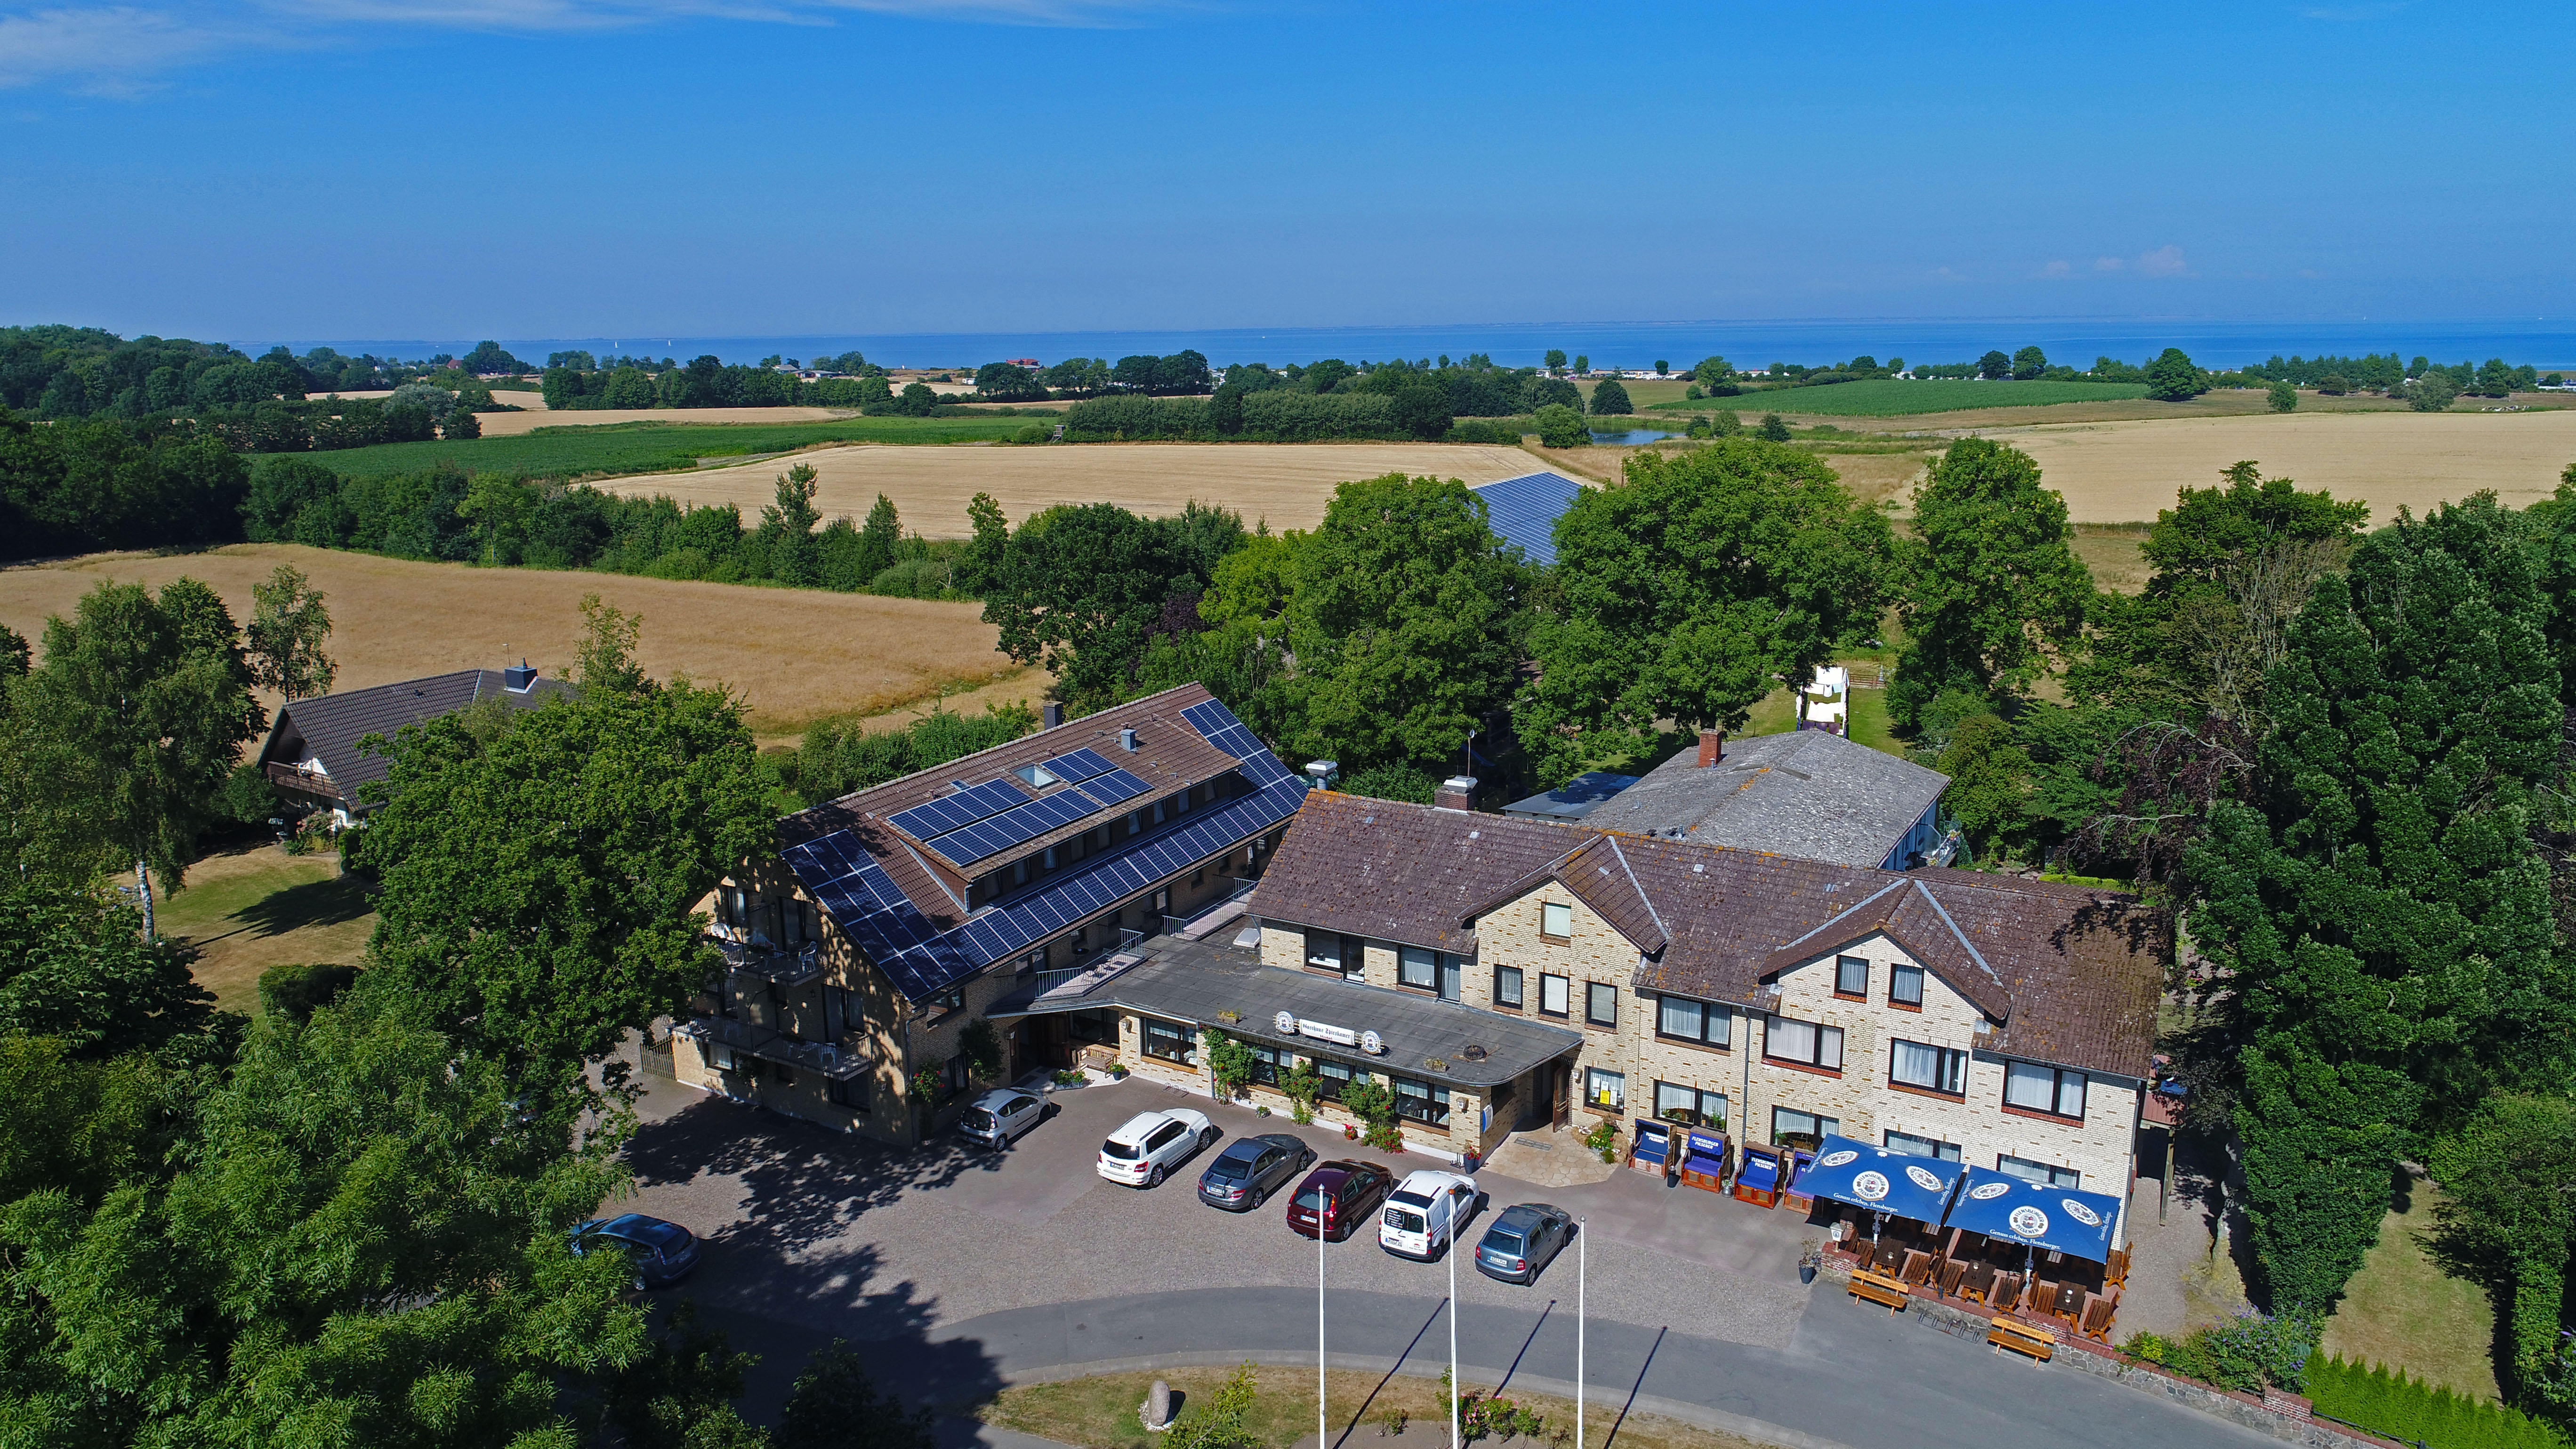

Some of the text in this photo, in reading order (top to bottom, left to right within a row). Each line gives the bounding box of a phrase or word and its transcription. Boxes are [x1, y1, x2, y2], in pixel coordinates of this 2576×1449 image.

[1691, 1136, 1719, 1147] FLENSBURGER
[1695, 1141, 1714, 1150] PILSENER
[1755, 1162, 1772, 1170] PILSENER
[1858, 1174, 1885, 1186] FLENSBURGER
[1858, 1188, 1880, 1197] PILSENER
[1834, 1192, 1899, 1213] Genuss erleben. Flensburger.
[2014, 1208, 2044, 1222] FLENSBURGER
[2016, 1224, 2039, 1234] PILSENER
[1989, 1229, 2061, 1250] Genuss erleben. Flensburger.
